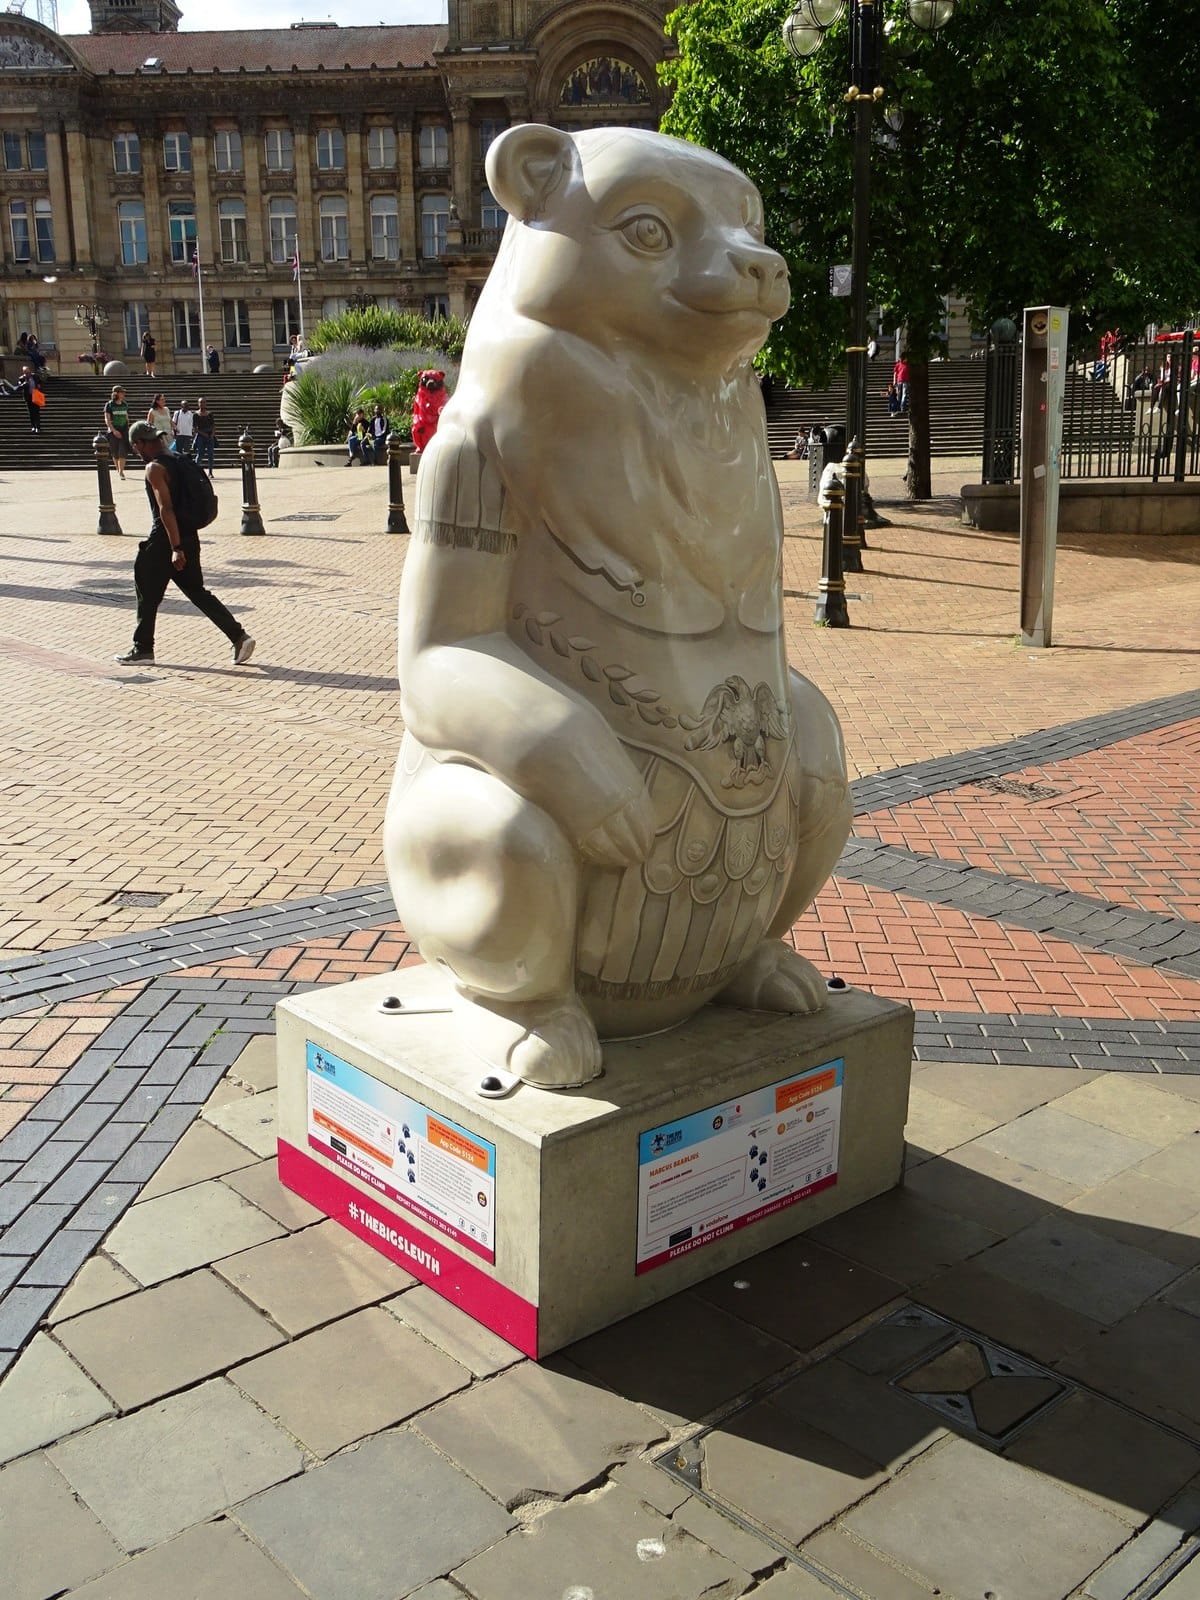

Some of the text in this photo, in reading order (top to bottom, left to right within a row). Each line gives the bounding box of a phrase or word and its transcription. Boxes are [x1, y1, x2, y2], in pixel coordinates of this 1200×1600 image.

[336, 1154, 386, 1191] PLEASE DO NOT CLIMB
[348, 1201, 440, 1277] #THEBIGSLEUTH
[669, 1242, 692, 1258] PLEASE
[692, 1238, 702, 1248] DO
[702, 1232, 715, 1244] NOT
[715, 1223, 734, 1237] CLIMB
